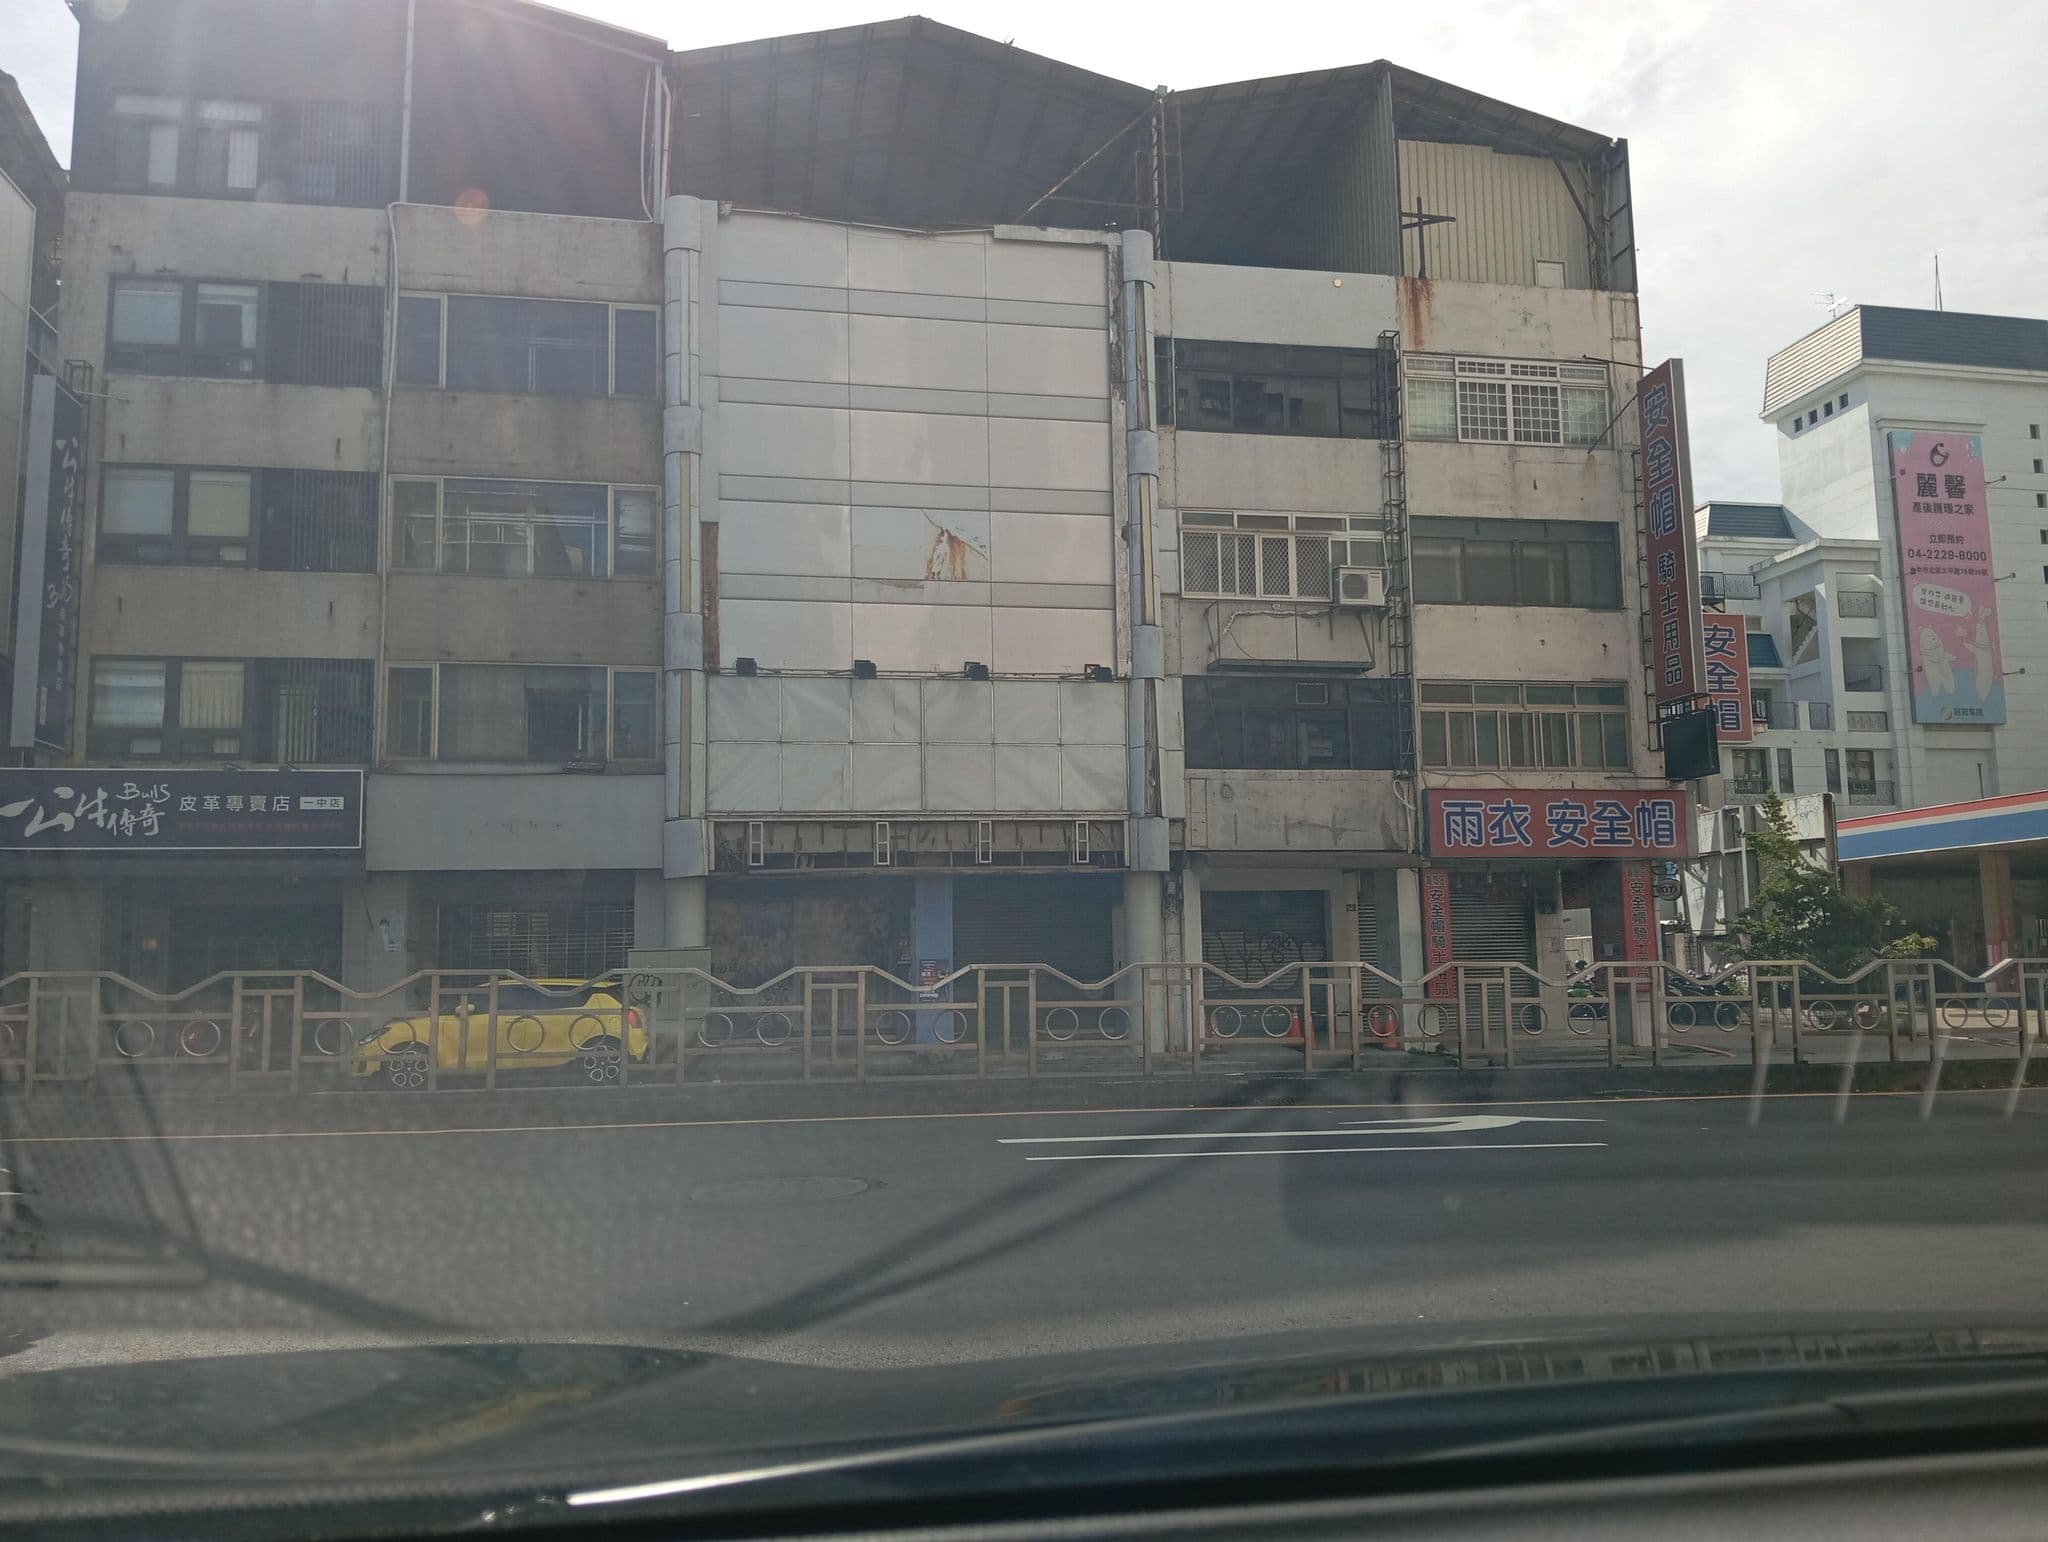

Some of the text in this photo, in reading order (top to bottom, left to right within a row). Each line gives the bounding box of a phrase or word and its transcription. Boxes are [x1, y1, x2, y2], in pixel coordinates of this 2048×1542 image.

[1643, 383, 1683, 686] 安全帽 騎士用品
[178, 795, 341, 812] 皮革專賣店 一中店
[1441, 798, 1676, 848] 雨衣 安全帽
